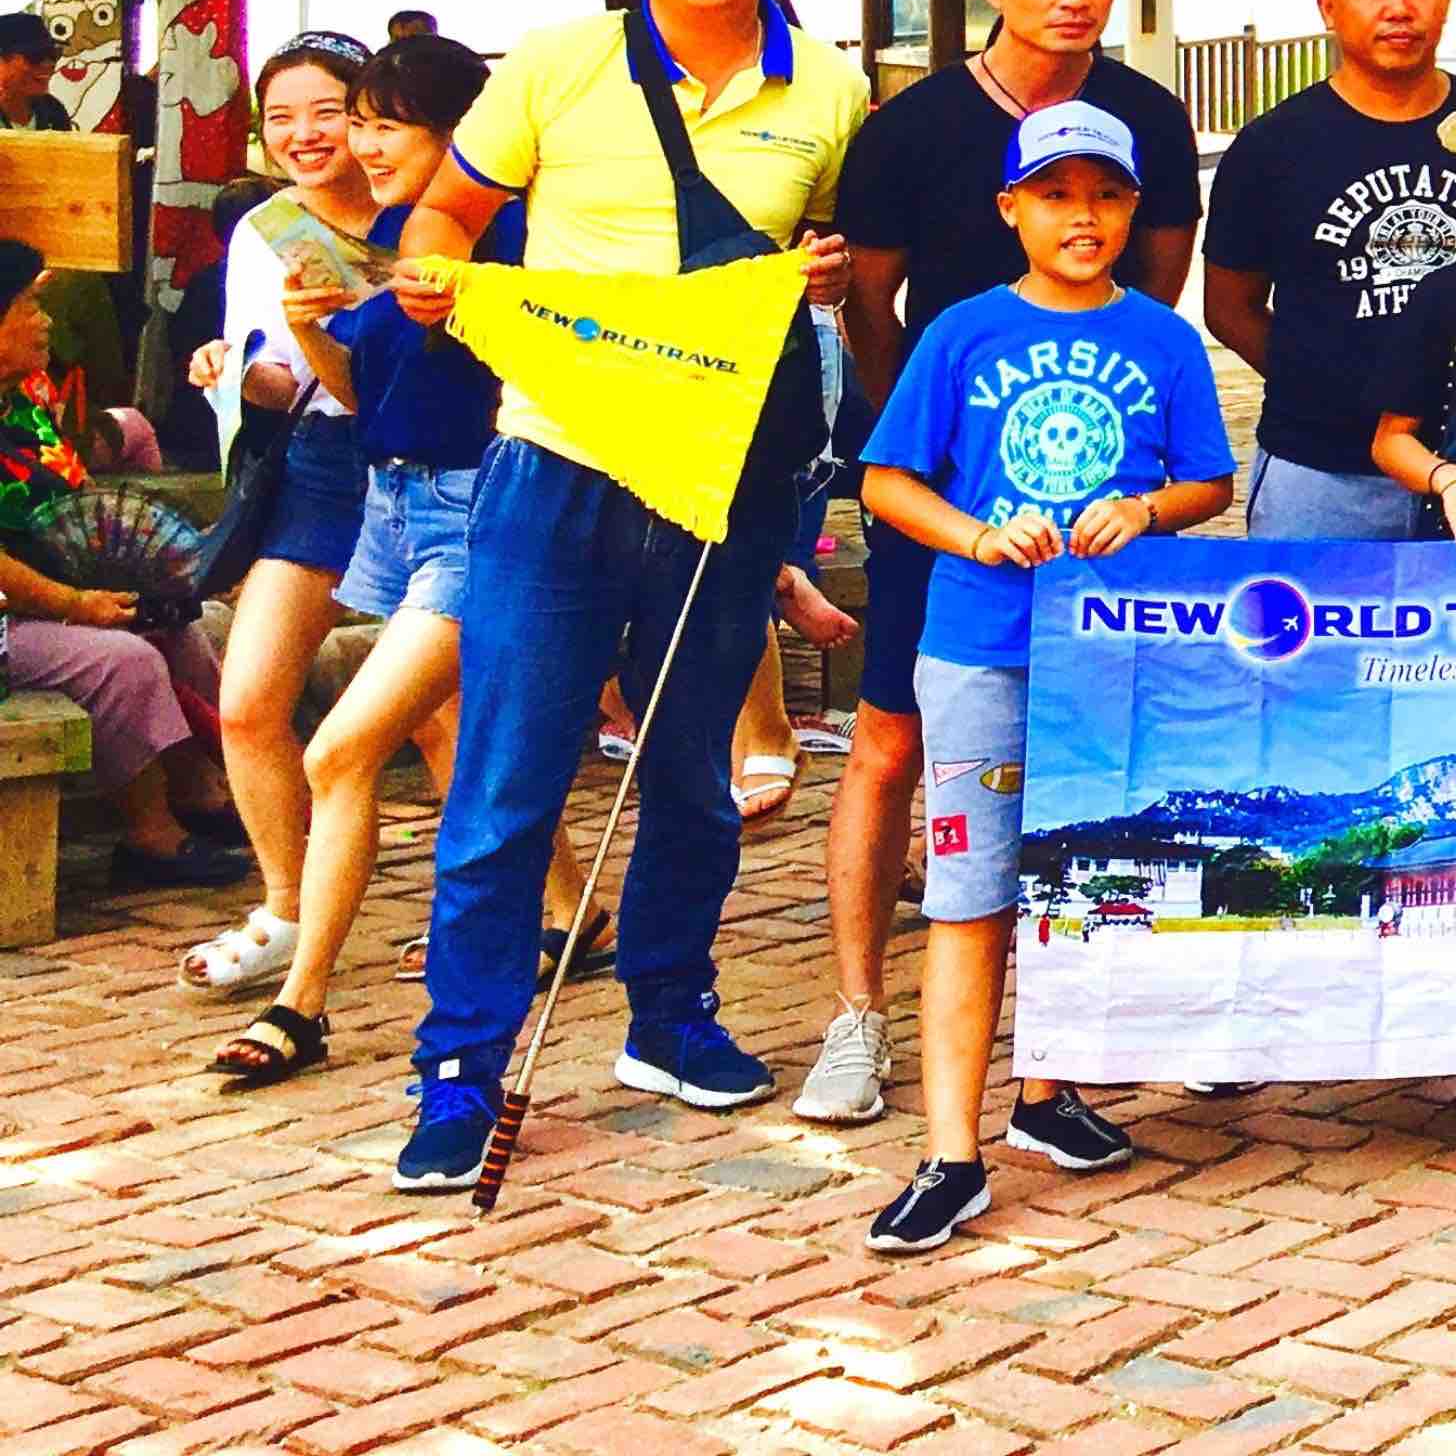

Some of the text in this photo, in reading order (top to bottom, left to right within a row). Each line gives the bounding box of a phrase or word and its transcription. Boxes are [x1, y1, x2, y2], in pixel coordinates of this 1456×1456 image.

[1355, 283, 1417, 320] ATH
[654, 343, 740, 375] TRAVEL
[967, 339, 1159, 420] VARSITY
